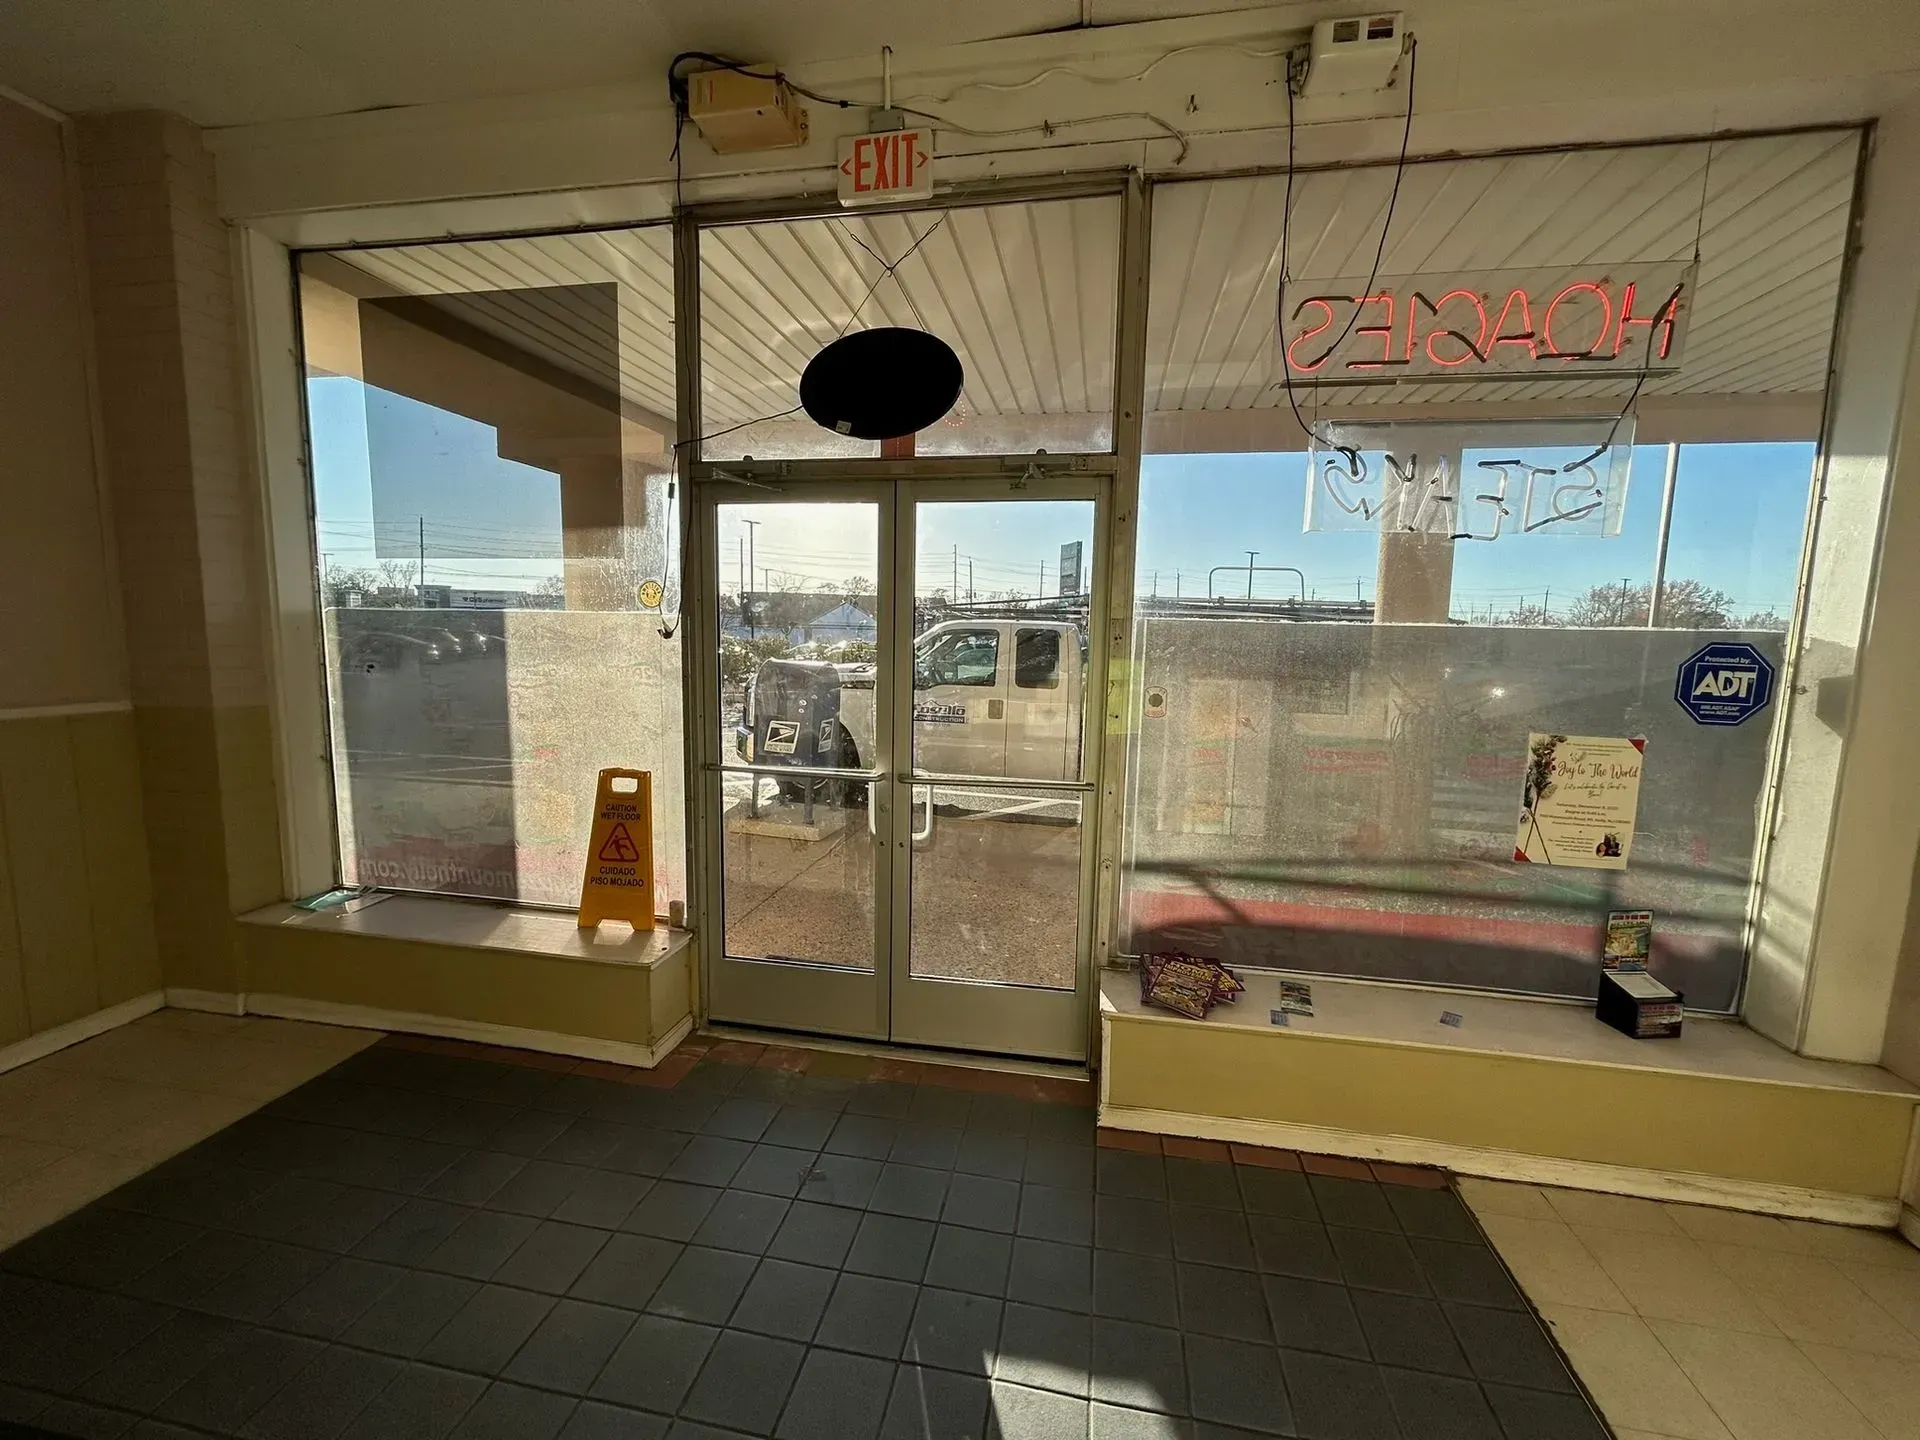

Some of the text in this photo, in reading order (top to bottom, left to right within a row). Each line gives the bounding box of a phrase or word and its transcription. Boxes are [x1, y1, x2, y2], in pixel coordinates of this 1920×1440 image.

[854, 133, 918, 192] EXIT
[1704, 655, 1739, 663] Protected
[1693, 670, 1757, 698] ADT
[1558, 761, 1640, 780] Joy to The World
[605, 803, 637, 812] CAUTION
[600, 811, 641, 821] WET FLOOR
[599, 865, 636, 876] CUIDADO
[590, 876, 644, 888] PISO MOJADO
[1165, 963, 1217, 986] IMPROVEMENT
